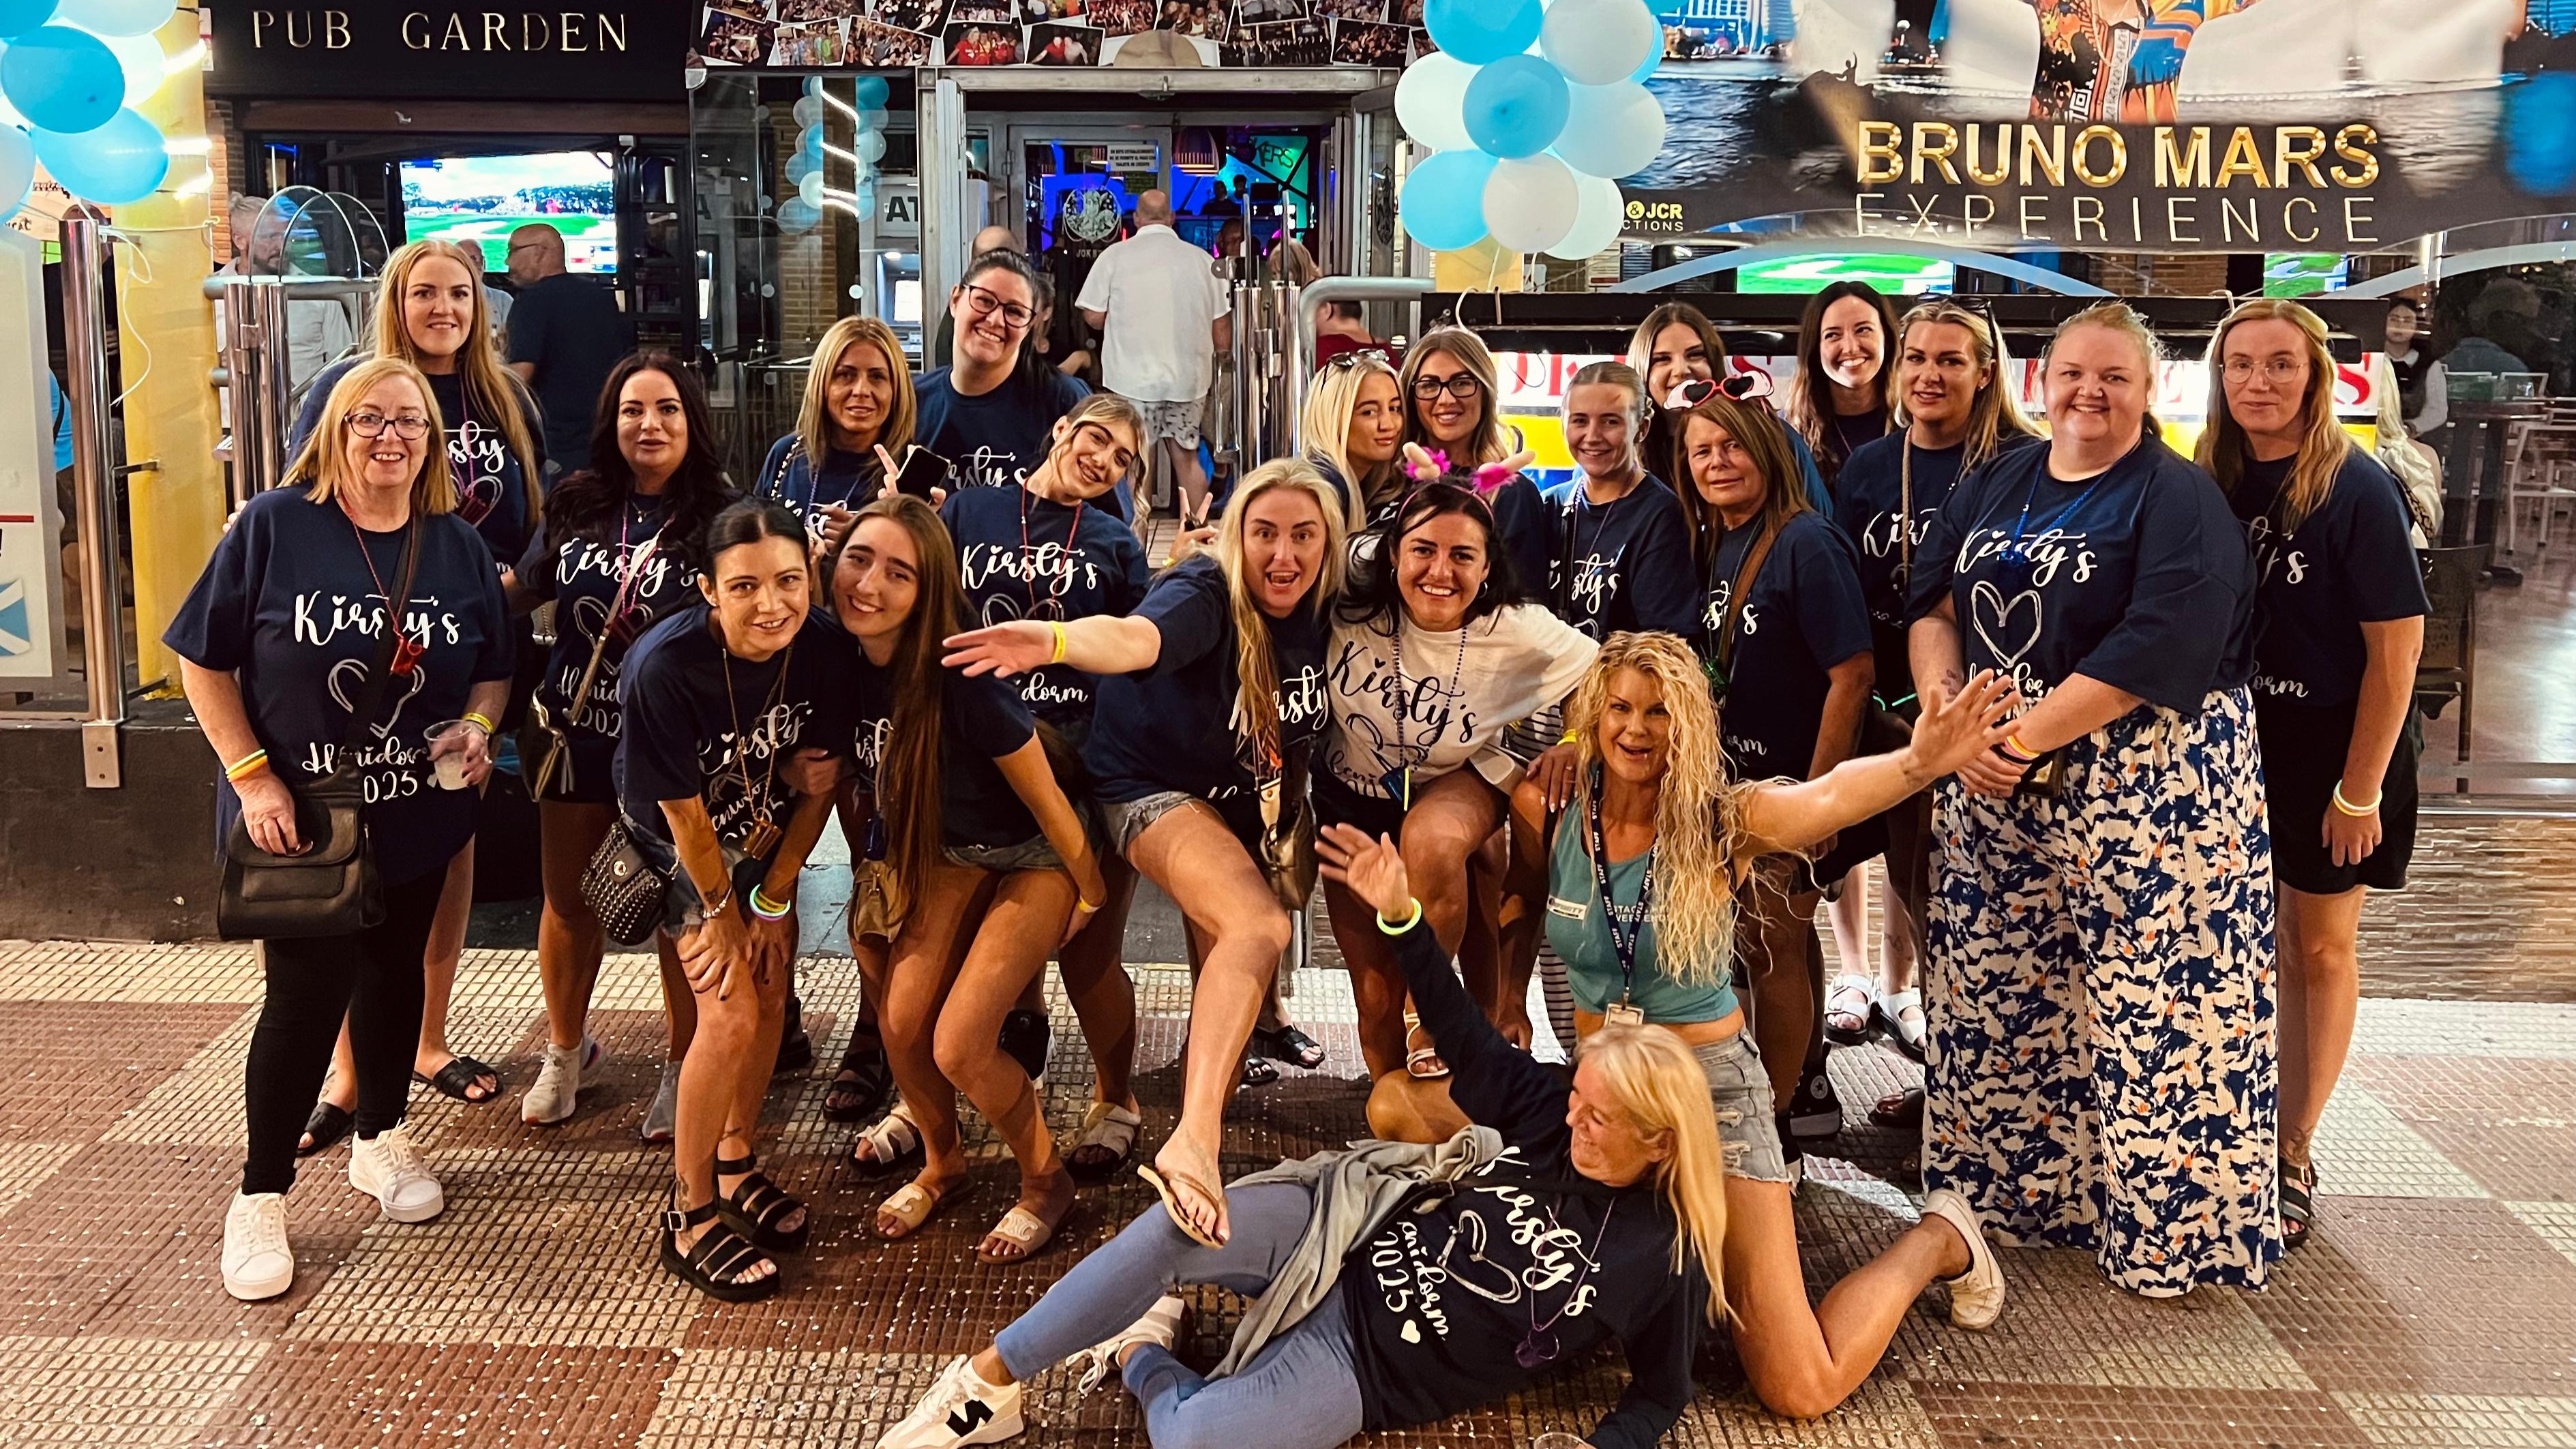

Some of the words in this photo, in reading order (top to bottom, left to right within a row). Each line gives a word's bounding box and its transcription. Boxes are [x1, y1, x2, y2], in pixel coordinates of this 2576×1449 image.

[252, 10, 351, 49] PUB
[402, 12, 626, 52] GARDEN
[1857, 121, 2127, 188] BRUNO
[2154, 123, 2379, 189] MARS
[886, 196, 918, 222] AT
[1645, 203, 1683, 219] JCR
[1856, 193, 2378, 242] EXPERIENCE
[961, 541, 1098, 596] Kirsty's
[580, 706, 622, 738] 202
[363, 771, 419, 803] 025
